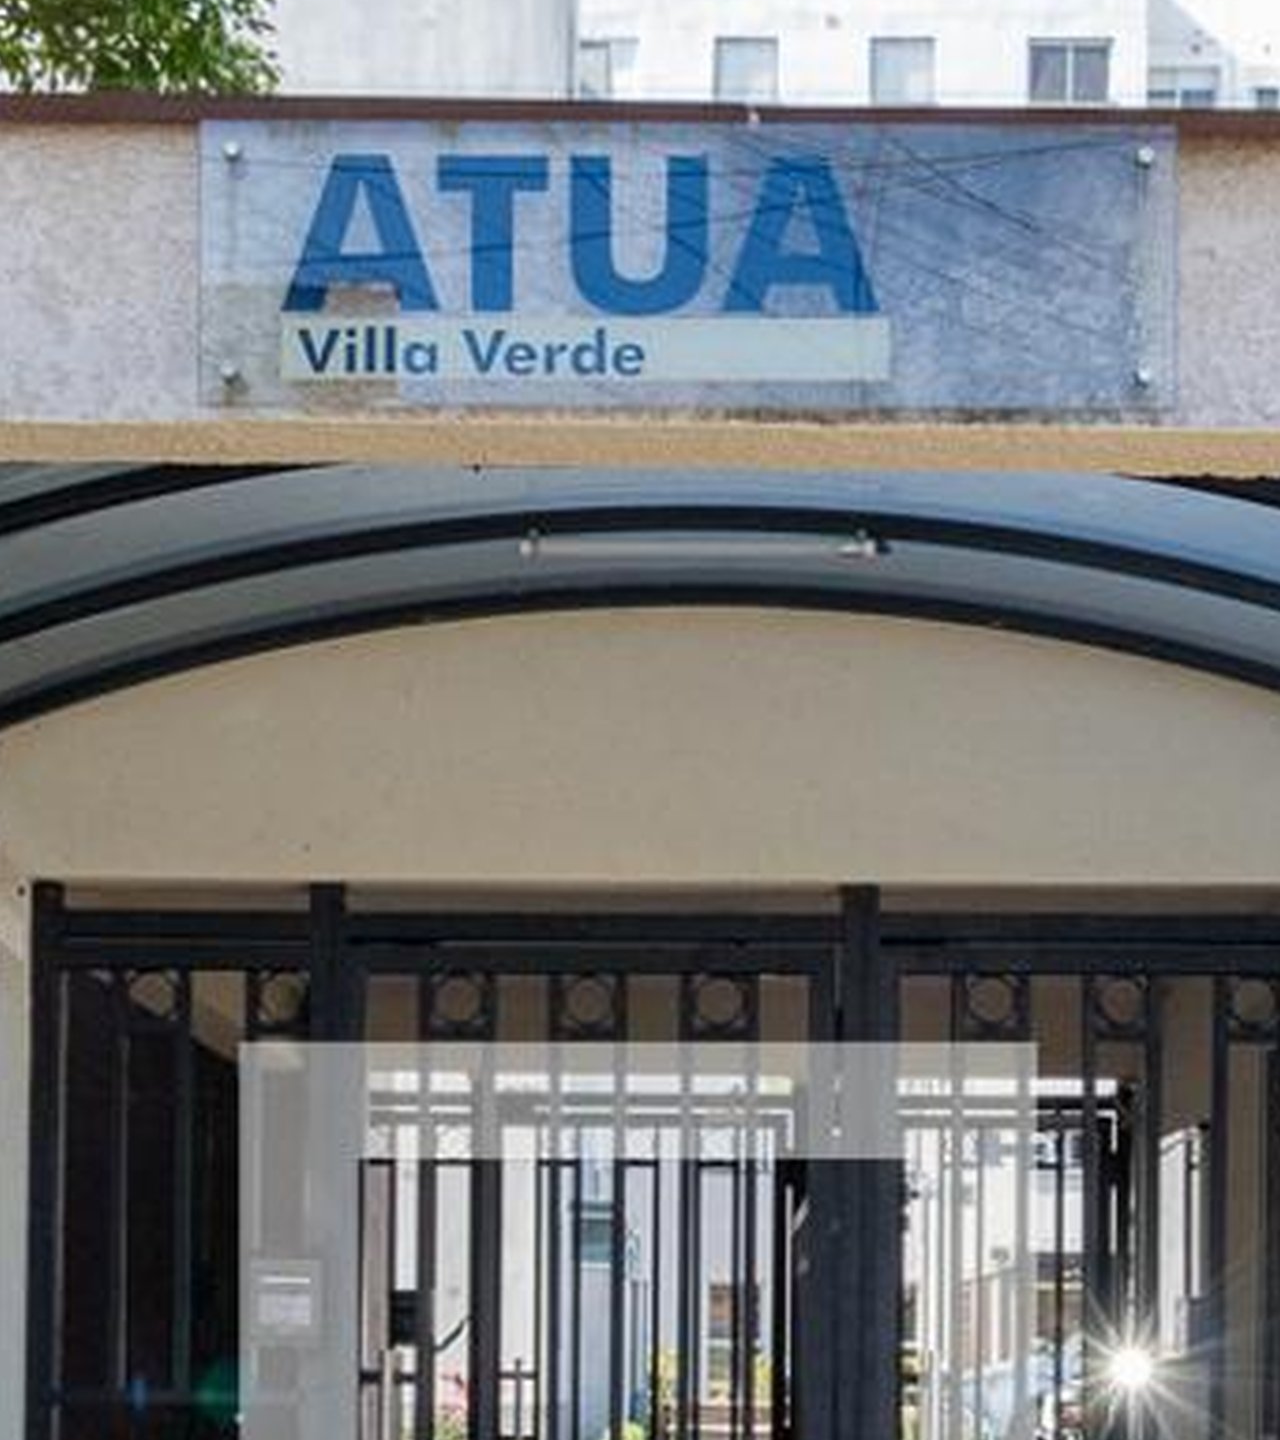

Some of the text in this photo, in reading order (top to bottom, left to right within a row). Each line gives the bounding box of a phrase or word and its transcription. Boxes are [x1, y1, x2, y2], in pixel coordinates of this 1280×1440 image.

[280, 154, 881, 317] ATUA
[297, 326, 646, 376] Villa Verde
